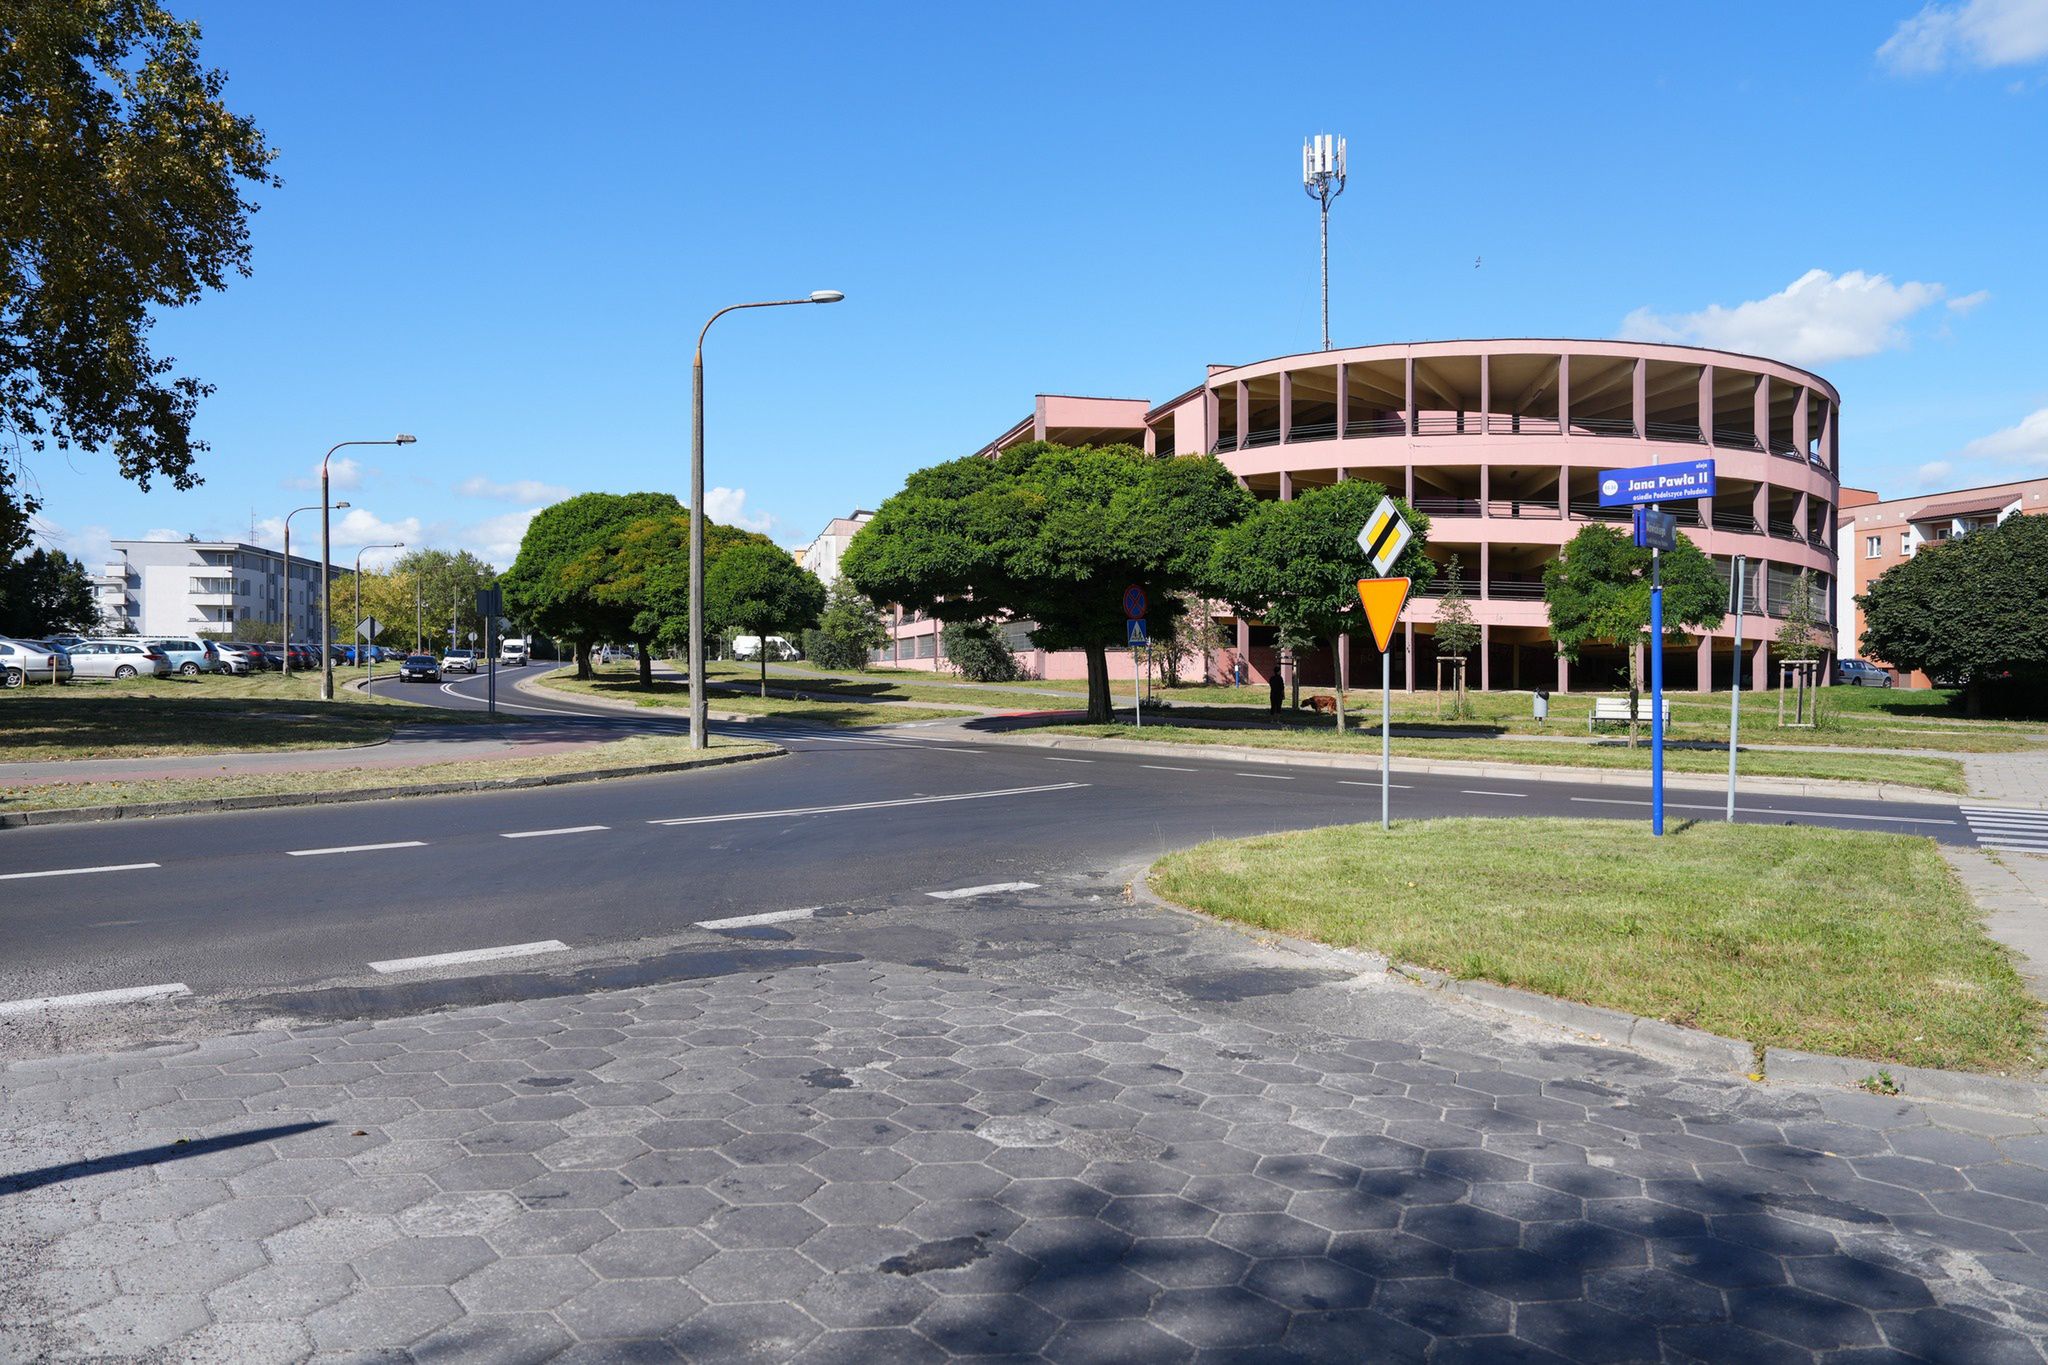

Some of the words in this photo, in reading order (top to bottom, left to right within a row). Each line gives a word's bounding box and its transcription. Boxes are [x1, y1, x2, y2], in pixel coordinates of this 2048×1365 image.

[1628, 479, 1655, 491] Jana
[1659, 473, 1694, 488] Pawła
[1699, 472, 1708, 483] II
[1633, 492, 1652, 500] osiedle
[1653, 491, 1682, 499] Podolszyce
[1684, 488, 1707, 496] Południe
